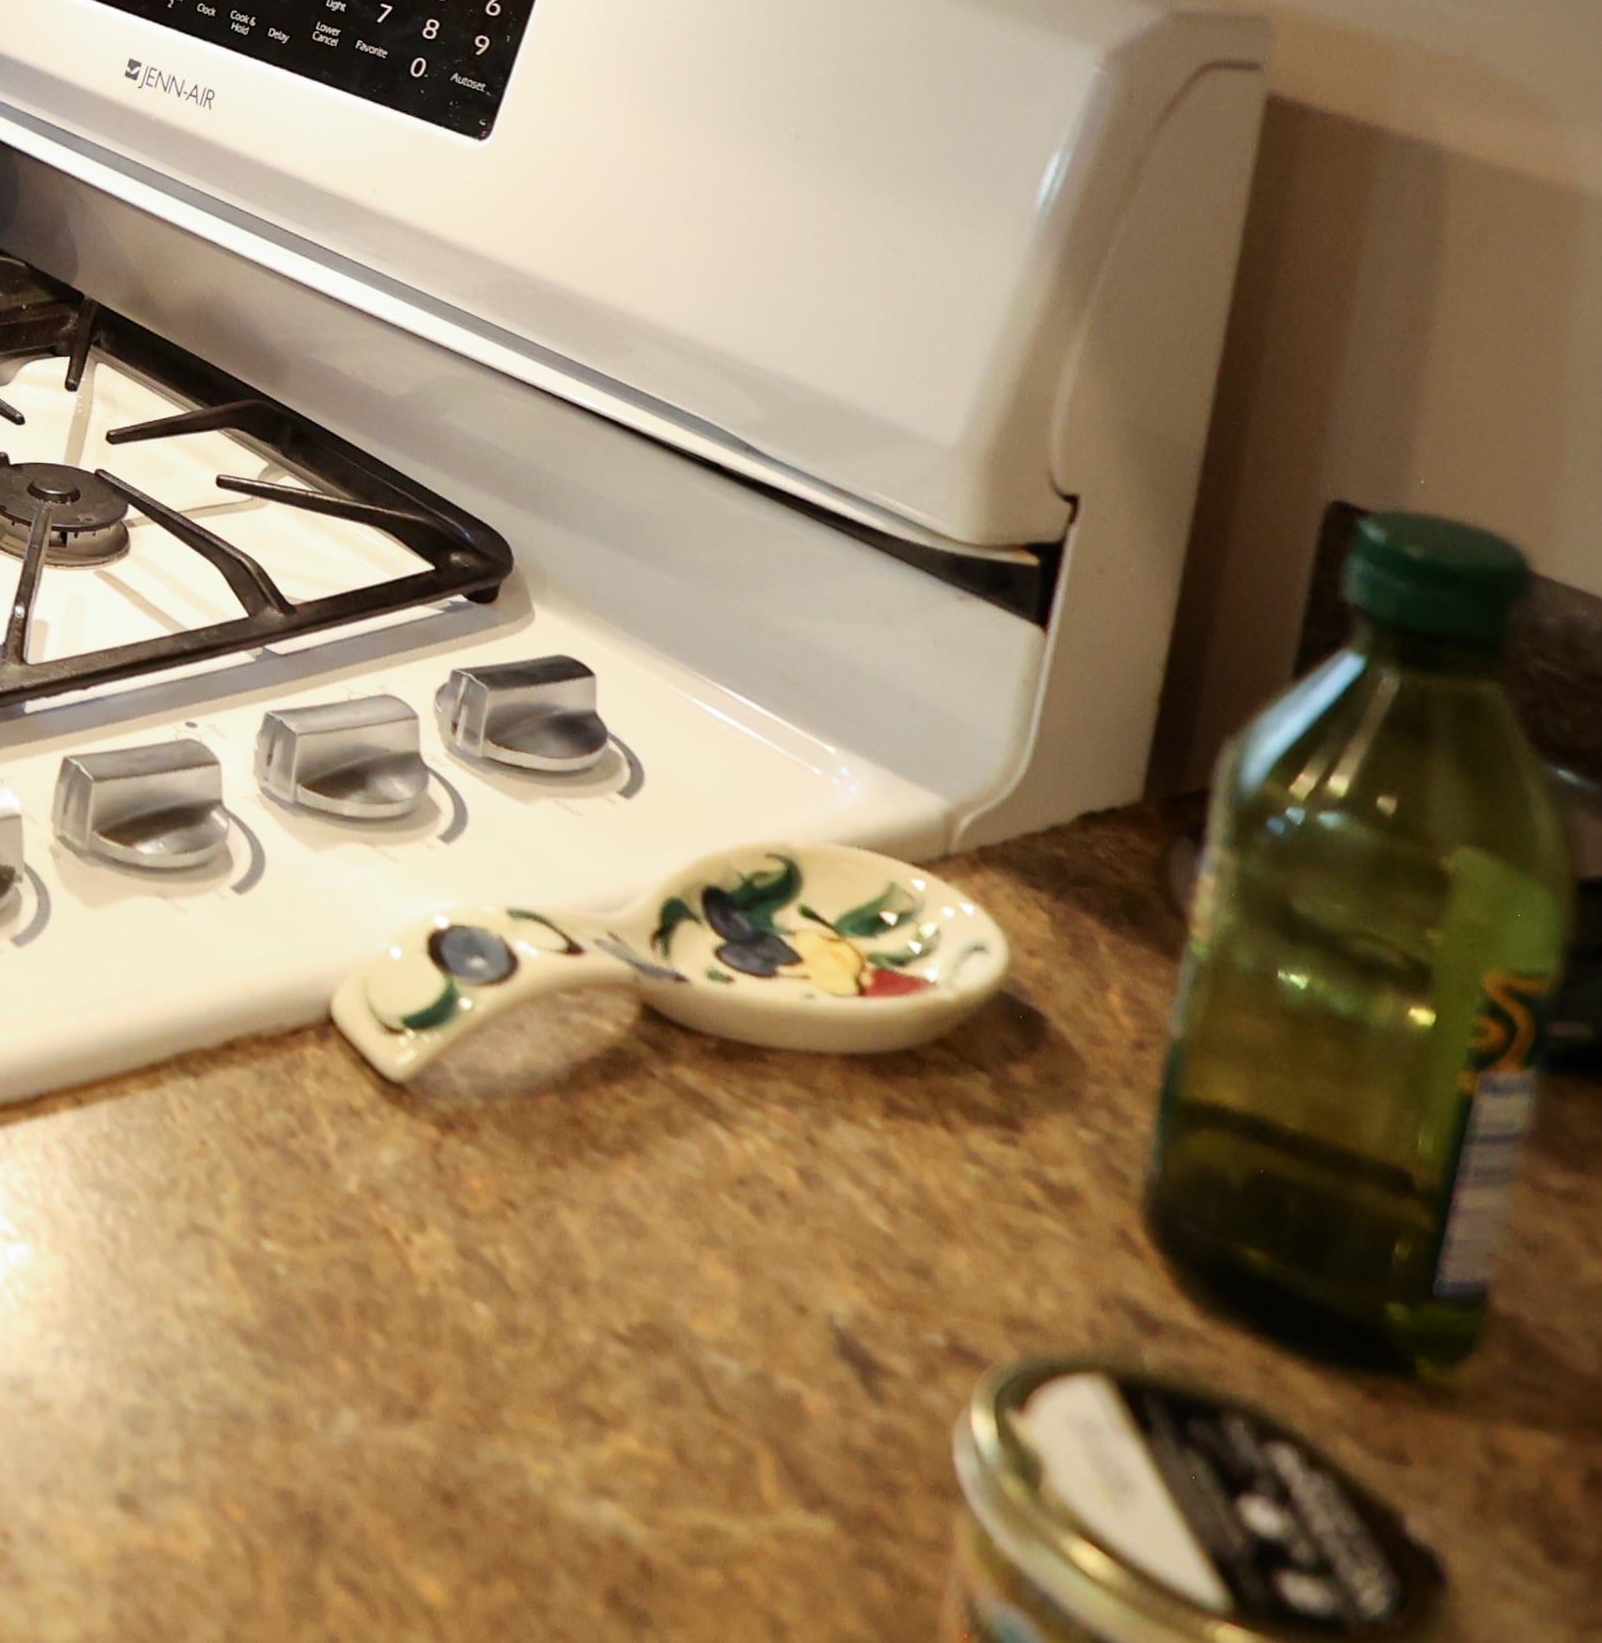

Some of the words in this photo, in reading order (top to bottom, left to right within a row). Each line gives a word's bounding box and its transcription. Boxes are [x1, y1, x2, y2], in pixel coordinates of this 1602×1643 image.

[167, 0, 175, 9] 2
[196, 3, 217, 17] Clock
[376, 3, 393, 23] 7
[230, 10, 250, 25] Cook
[230, 22, 250, 36] Hold
[267, 28, 291, 44] Delay
[315, 21, 342, 37] Lower
[422, 18, 441, 40] 8
[312, 31, 340, 48] Cancel
[474, 35, 490, 56] 9
[354, 40, 389, 59] Favorite
[410, 57, 427, 78] 0
[138, 65, 216, 110] JENN-AIR
[450, 72, 486, 92] Autoset
